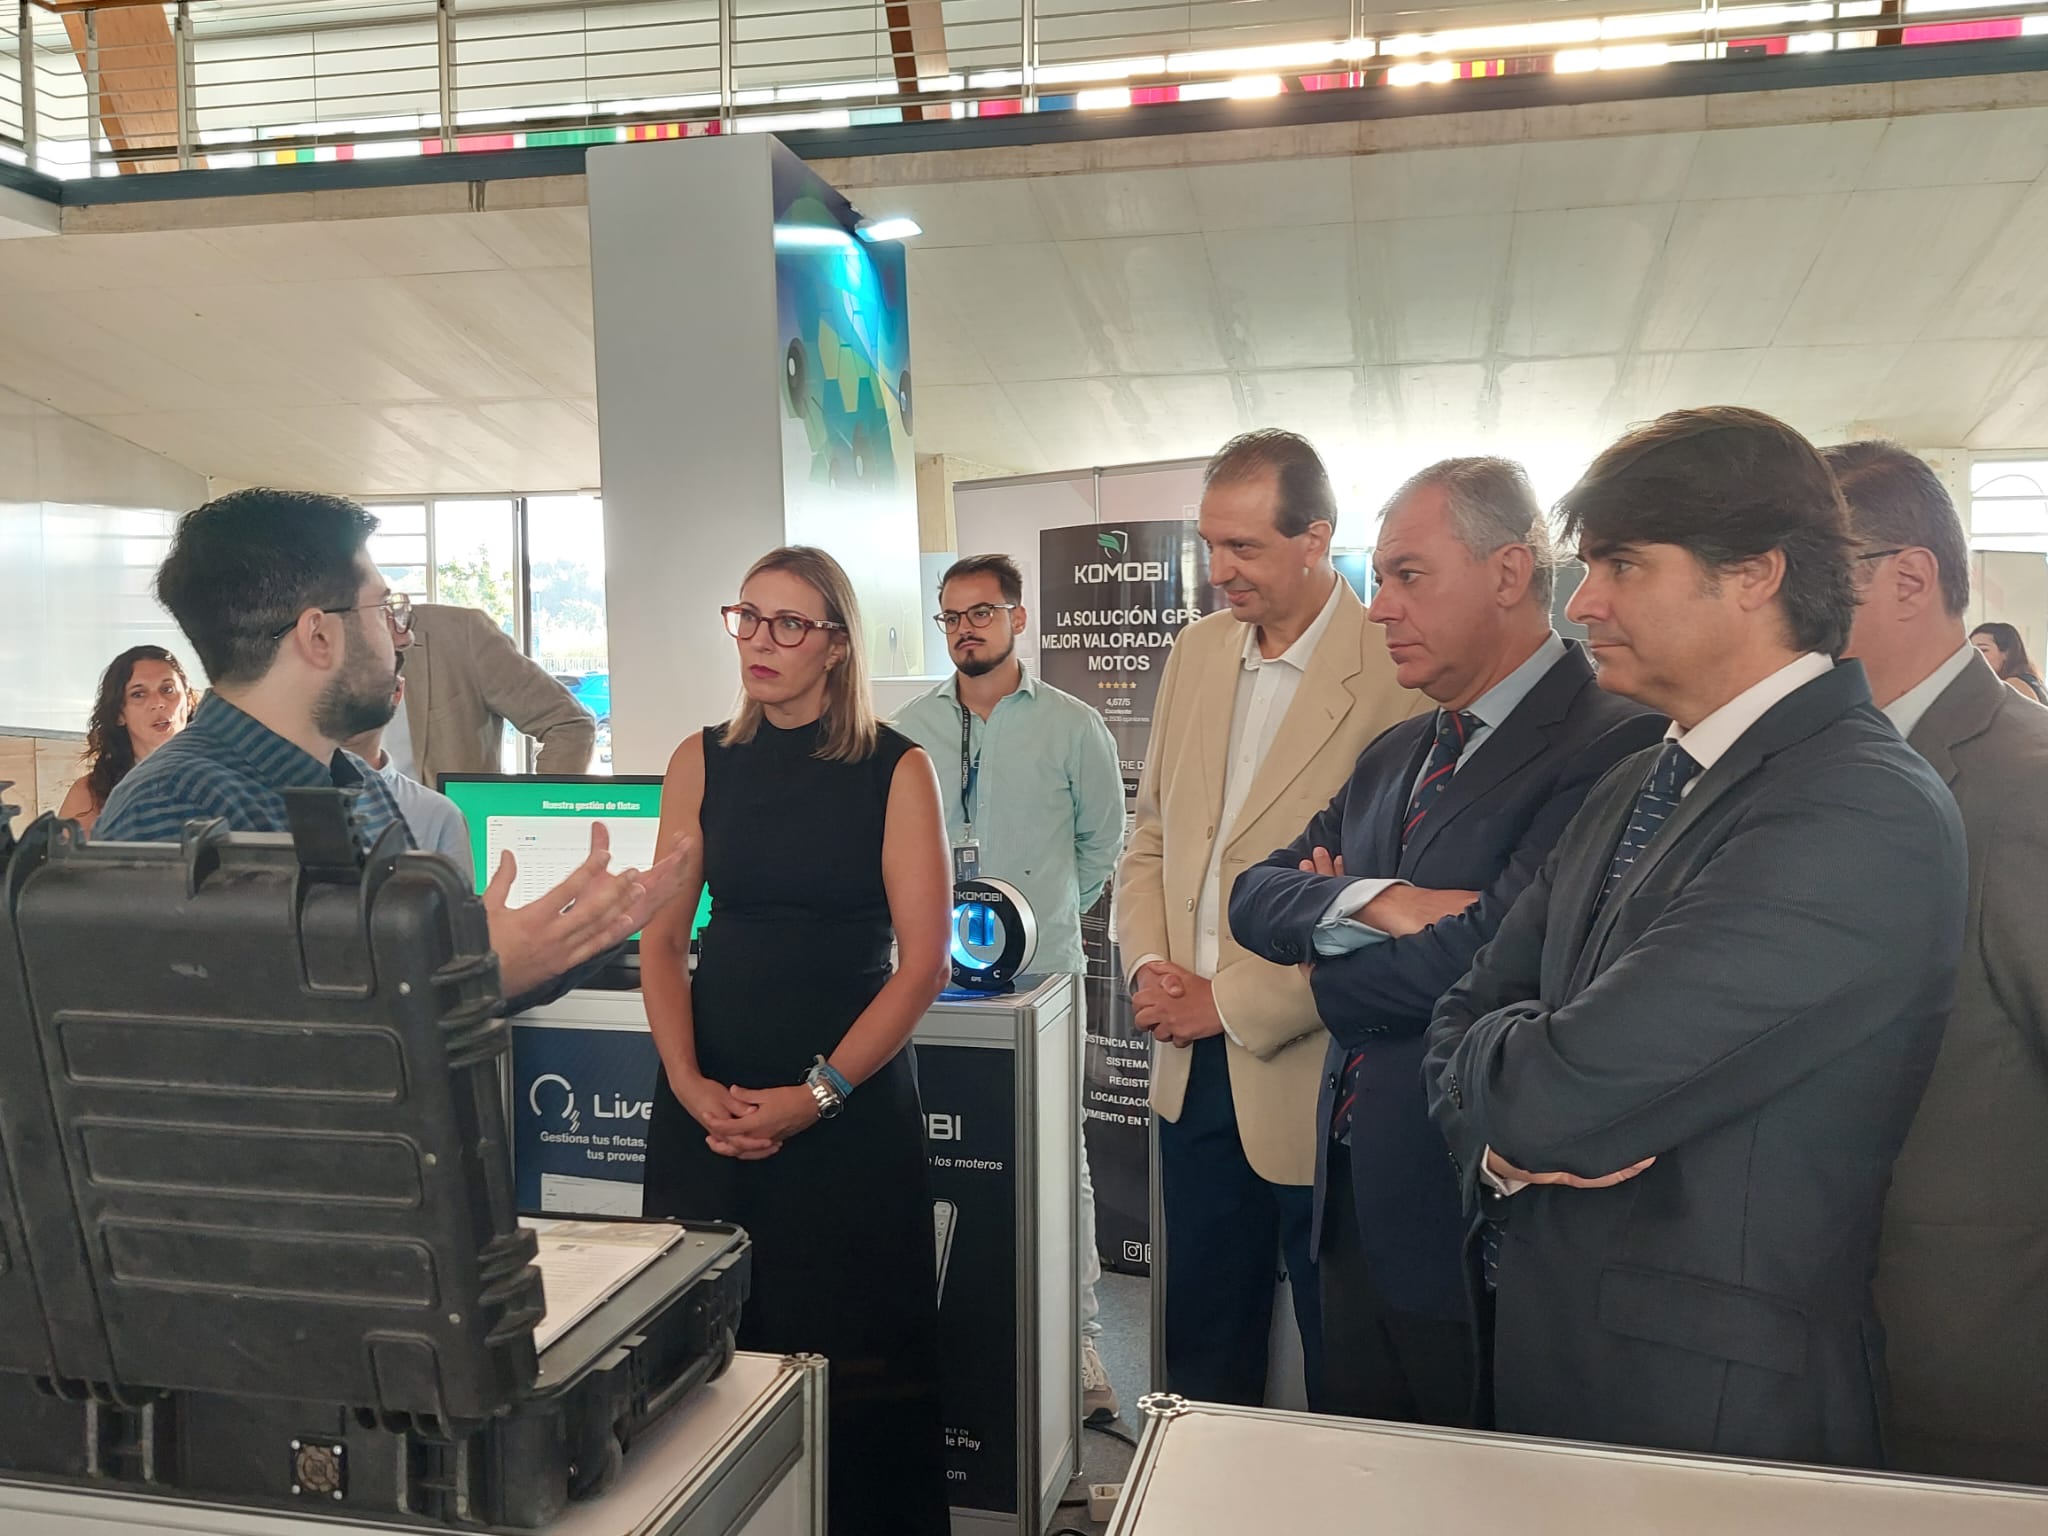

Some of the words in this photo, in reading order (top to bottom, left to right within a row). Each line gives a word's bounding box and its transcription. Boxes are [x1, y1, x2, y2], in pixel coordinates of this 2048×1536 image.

[1074, 561, 1169, 584] KOMOBI
[1057, 611, 1071, 627] LA
[1073, 605, 1157, 626] SOLUCIÓN
[1161, 608, 1202, 625] GPS
[1041, 633, 1081, 649] MEJOR
[1083, 632, 1175, 648] VALORADA
[1088, 655, 1150, 671] MOTOS
[957, 891, 1003, 903] KOMOBI
[1129, 1040, 1144, 1050] EN
[1105, 1056, 1149, 1069] SISTEMA
[593, 1093, 654, 1120] Live
[1127, 1115, 1142, 1126] EN
[540, 1130, 590, 1145] Gestiona
[592, 1134, 610, 1145] tus
[612, 1135, 648, 1149] flotas,
[586, 1149, 604, 1160] tus
[607, 1151, 646, 1163] provee
[934, 1155, 952, 1167] los
[954, 1158, 1004, 1171] moteros
[957, 1436, 981, 1452] Play
[946, 1469, 967, 1481] om
